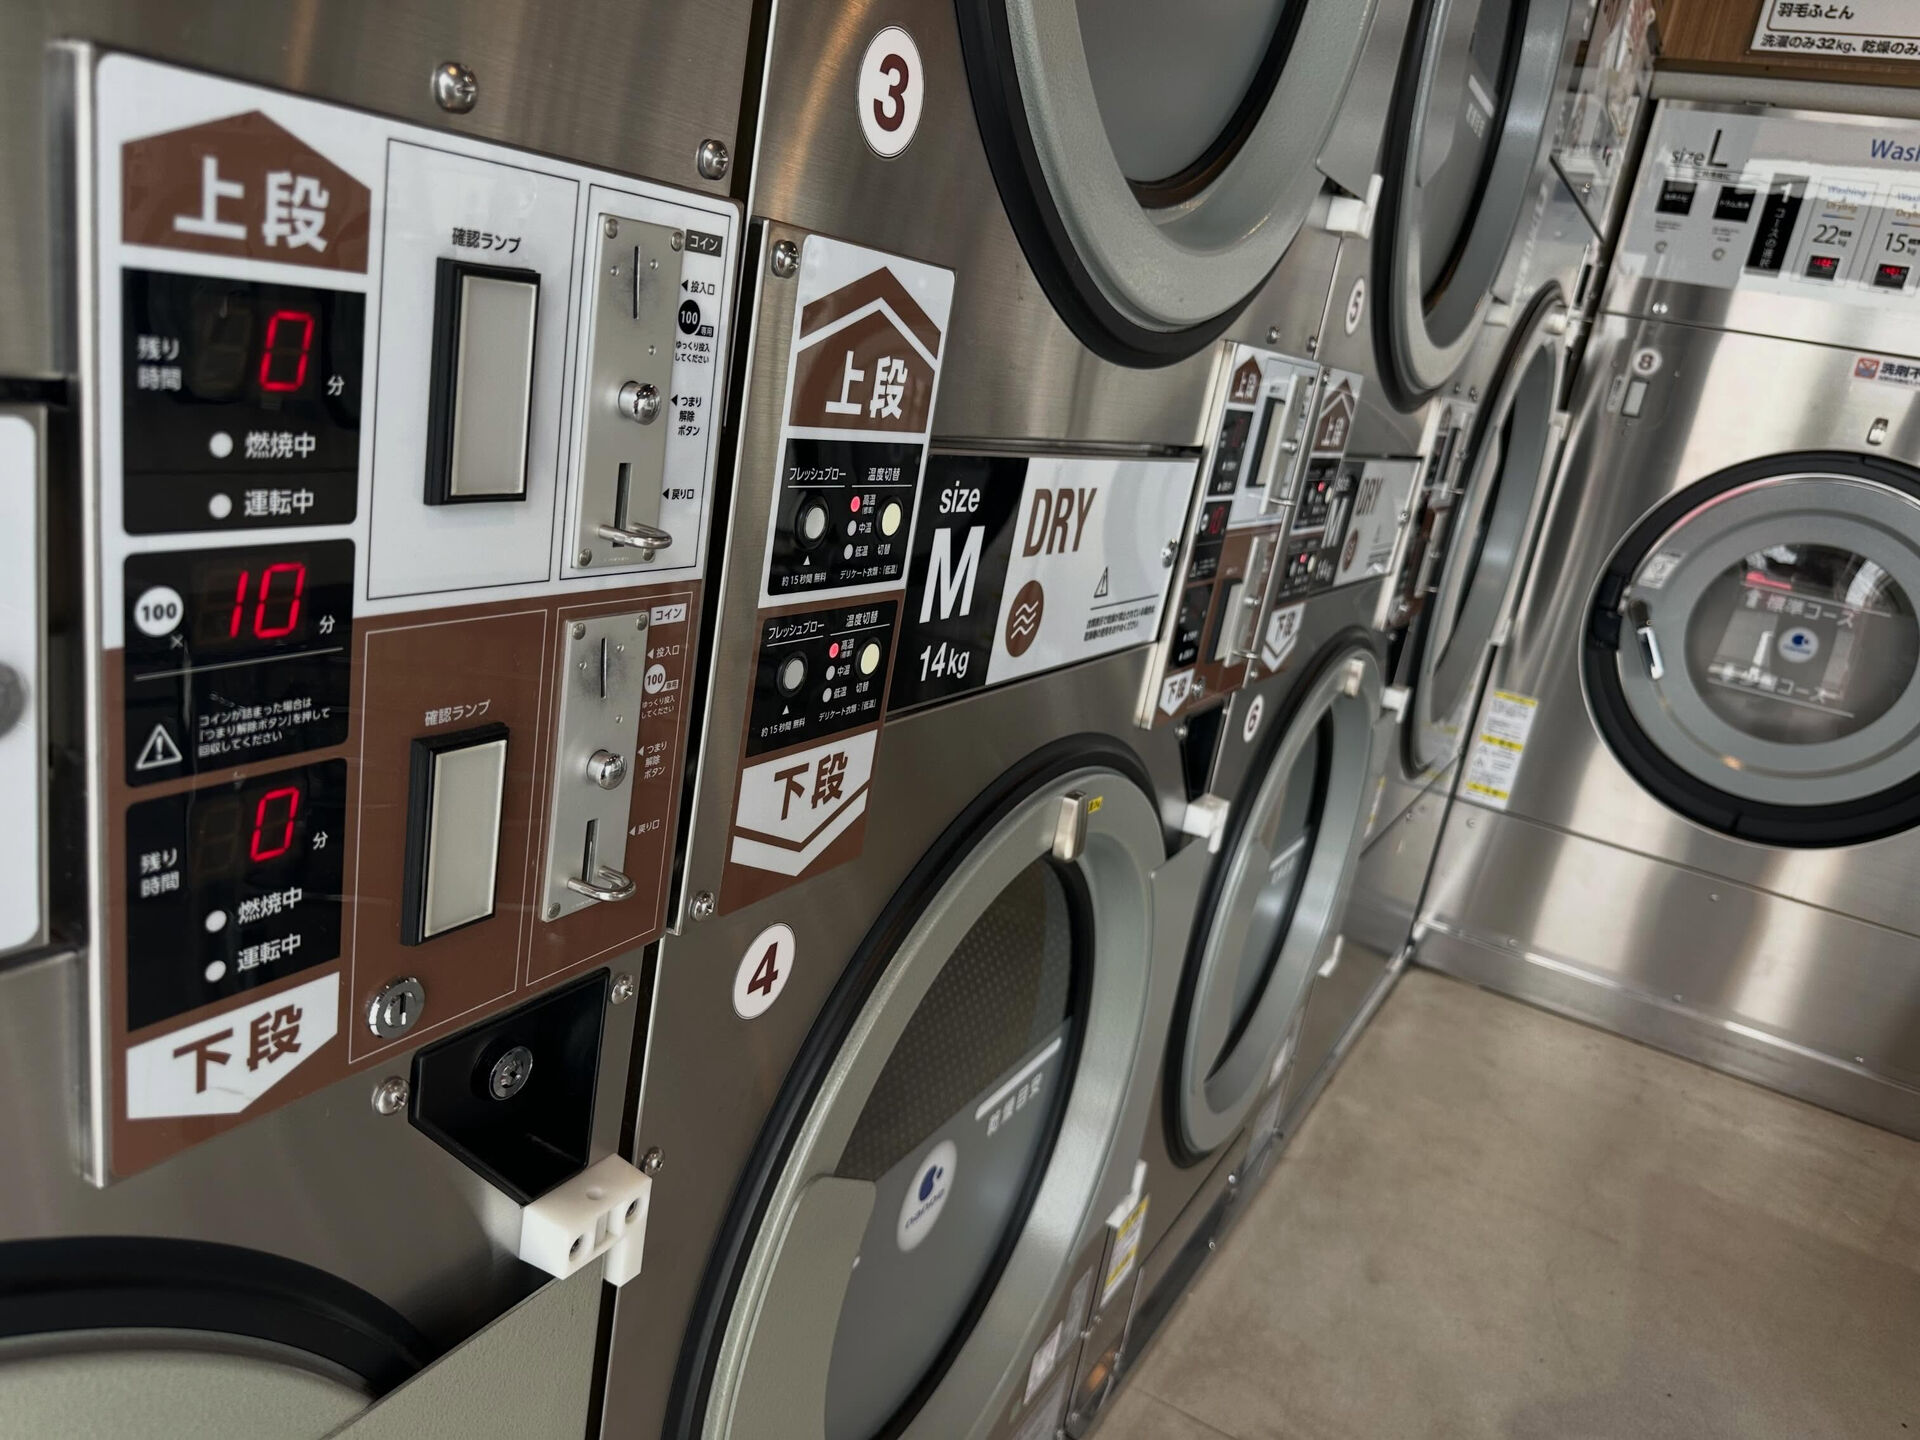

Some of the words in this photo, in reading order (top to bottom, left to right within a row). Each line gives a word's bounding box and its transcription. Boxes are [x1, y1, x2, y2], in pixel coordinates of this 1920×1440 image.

[1778, 2, 1854, 20] 羽毛ふとん
[873, 53, 910, 132] 3
[1706, 129, 1728, 168] L
[173, 154, 330, 252] 上段
[1780, 183, 1793, 203] 1
[452, 227, 521, 254] 確認ランプ
[690, 235, 718, 251] コイン
[1812, 224, 1839, 245] 22
[1885, 232, 1909, 253] 15
[690, 281, 715, 295] 投入口
[681, 311, 698, 325] 100
[1349, 290, 1362, 324] 5
[137, 335, 180, 362] 残り
[259, 310, 315, 391] 0
[137, 366, 182, 392] 時間
[327, 375, 345, 397] 分
[825, 350, 908, 419] 上段
[680, 396, 701, 407] つまり
[678, 425, 700, 436] ボタン
[245, 431, 316, 459] 燃焼中
[789, 467, 847, 481] フレッシュブロー
[868, 467, 901, 482] 温度切替
[244, 489, 314, 517] 運転中
[671, 488, 694, 500] 戻り口
[939, 480, 981, 514] size
[1022, 488, 1098, 558] DRY
[919, 525, 985, 624] M
[143, 602, 177, 622] 100
[229, 562, 306, 639] 10
[319, 615, 335, 635] 分
[655, 608, 682, 621] コイン
[846, 610, 879, 628] 温度切替
[768, 620, 825, 640] フレッシュブロー
[656, 645, 680, 659] 投入口
[920, 642, 969, 682] 14kg
[647, 673, 663, 687] 100
[424, 699, 491, 727] 確認ランプ
[1248, 704, 1260, 733] 6
[647, 741, 667, 754] つまり
[644, 766, 666, 779] ボタン
[774, 751, 848, 821] 下段
[250, 786, 300, 862] 0
[638, 820, 660, 834] 戻り口
[313, 831, 329, 850] 分
[140, 848, 178, 874] 残り
[140, 871, 180, 898] 時間
[238, 886, 303, 924] 燃焼中
[237, 933, 301, 973] 運転中
[747, 941, 779, 996] 4
[172, 1004, 303, 1094] 下段
